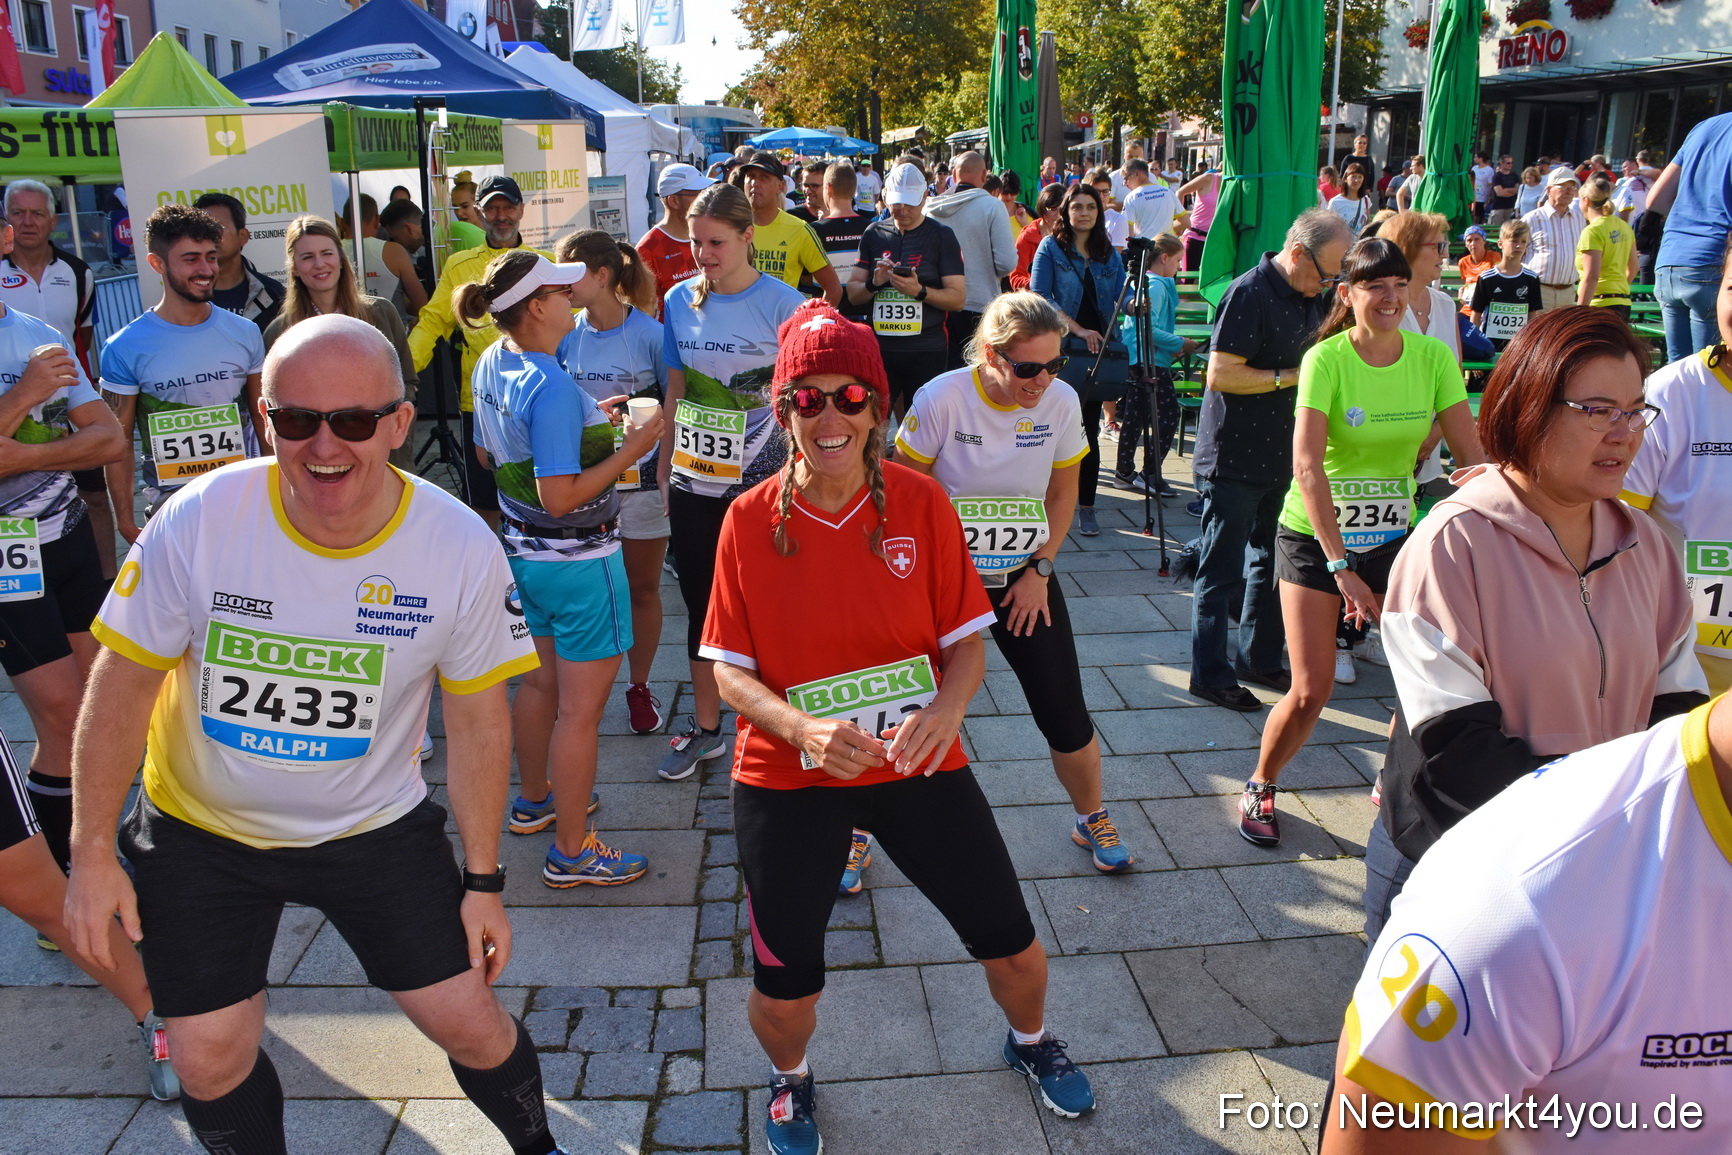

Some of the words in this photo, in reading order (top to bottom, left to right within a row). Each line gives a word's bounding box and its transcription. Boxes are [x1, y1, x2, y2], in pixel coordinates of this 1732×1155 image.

[1498, 29, 1567, 69] RENO
[512, 170, 549, 191] POWER
[550, 169, 580, 189] PLATE
[754, 249, 787, 260] BERLIN
[2, 276, 20, 284] tkn
[878, 305, 916, 320] 1339
[1494, 304, 1525, 313] BOCK
[879, 323, 912, 331] MARKUS
[1492, 315, 1524, 327] 4032
[157, 407, 230, 431] BOCK
[681, 404, 739, 431] BOCK
[1015, 432, 1053, 440] Neumarkter
[1016, 422, 1033, 433] 20
[163, 431, 235, 460] 5134
[681, 426, 733, 460] 5133
[955, 431, 982, 444] BOCK
[1015, 439, 1045, 448] Stadtlauf
[1692, 442, 1732, 452] BOCK
[690, 459, 715, 475] JANA
[960, 502, 1040, 519] BOCK
[964, 527, 1038, 551] 2127
[360, 583, 393, 605] 20
[396, 597, 425, 607] JAHRE
[1703, 583, 1732, 617] 1
[213, 592, 273, 615] BOCK
[357, 607, 435, 624] Neumarkter
[355, 622, 418, 640] Stadtlauf
[218, 631, 370, 678] BOCK
[802, 666, 921, 714] BOCK
[219, 675, 358, 730] 2433
[365, 696, 374, 704] D
[240, 731, 328, 757] RALPH
[1380, 943, 1459, 1043] 20
[1679, 1059, 1690, 1069] by
[1692, 1059, 1718, 1067] smart
